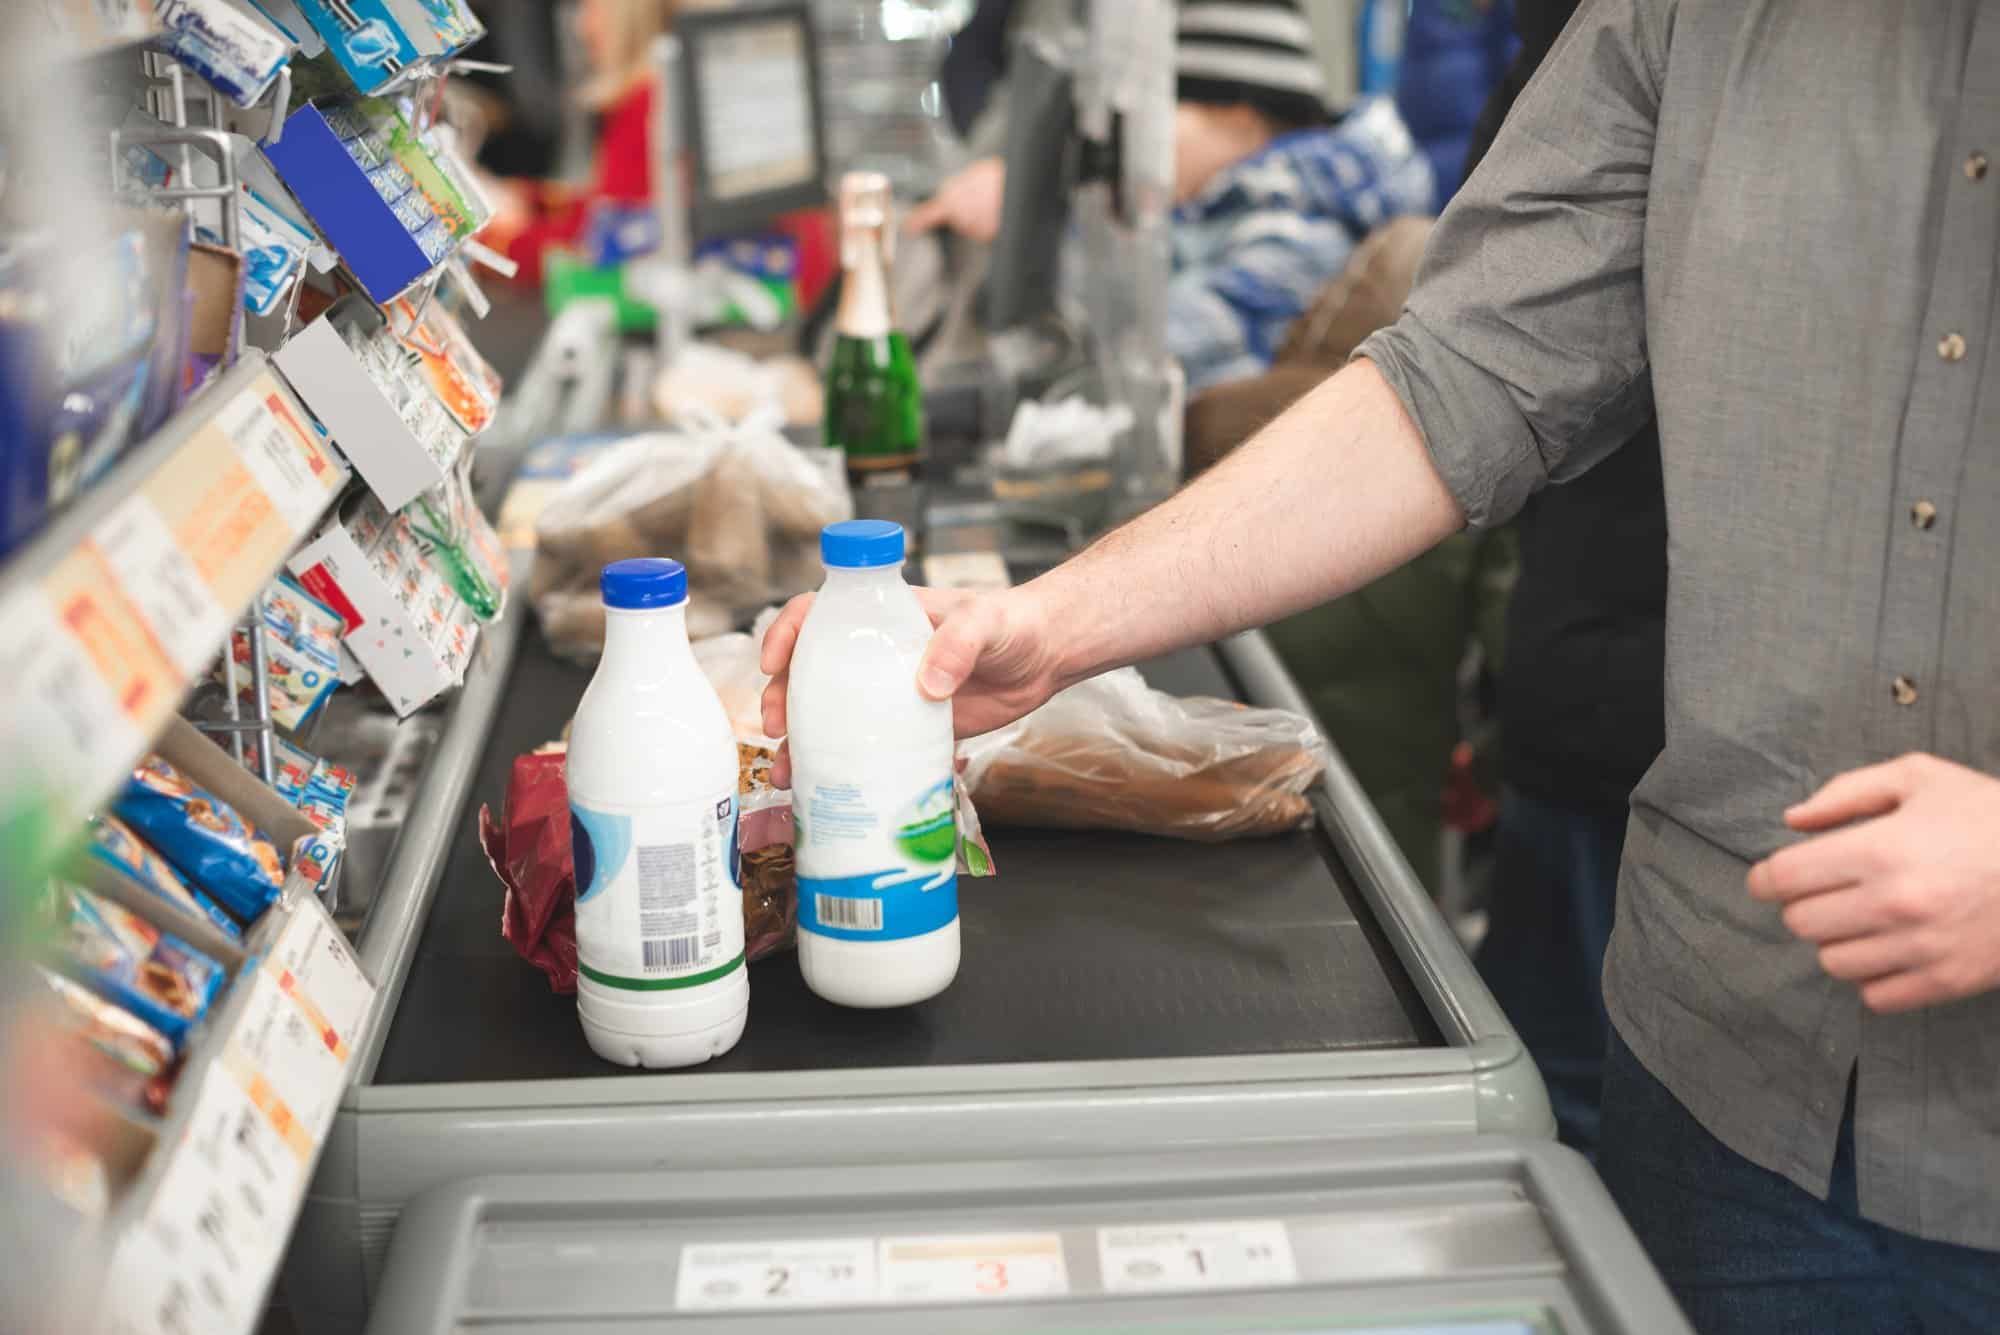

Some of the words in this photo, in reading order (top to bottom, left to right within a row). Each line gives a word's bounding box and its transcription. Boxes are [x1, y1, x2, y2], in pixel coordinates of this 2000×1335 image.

[975, 1261, 1009, 1294] 3
[1187, 1247, 1207, 1277] 1
[764, 1265, 790, 1296] 2
